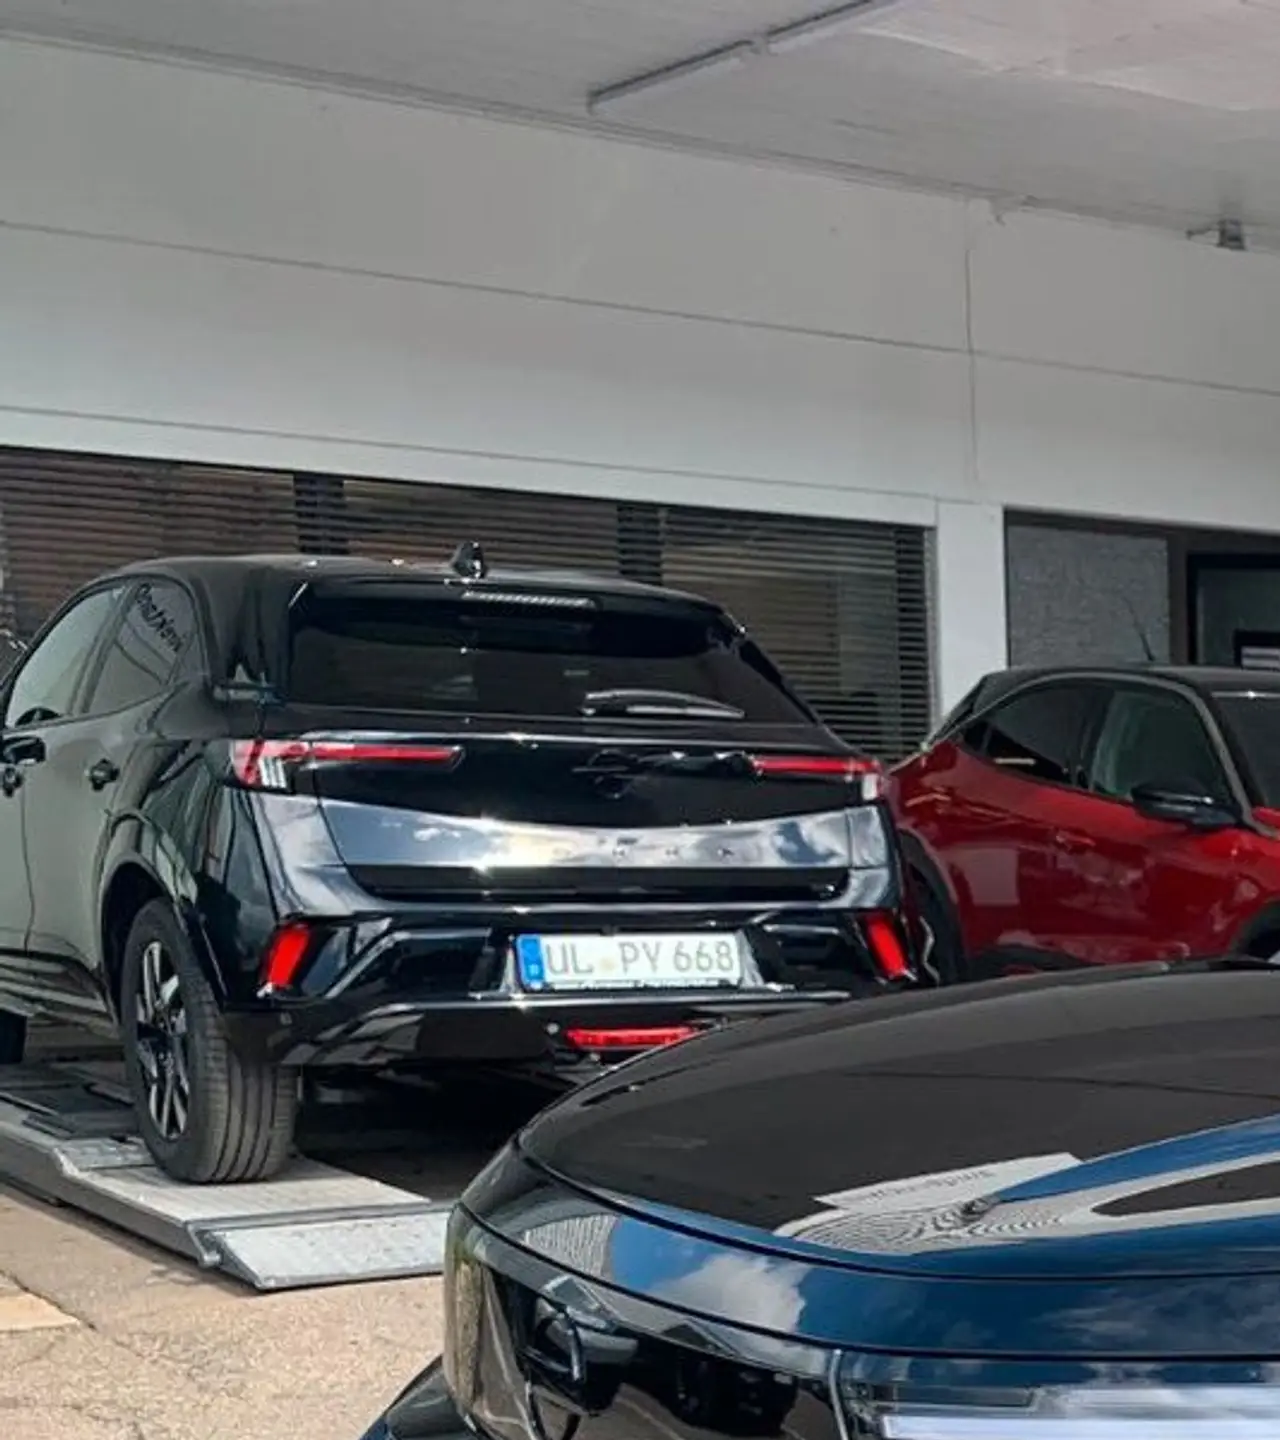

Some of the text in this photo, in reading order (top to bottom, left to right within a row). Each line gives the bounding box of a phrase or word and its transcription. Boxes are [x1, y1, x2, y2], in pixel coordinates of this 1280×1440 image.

[546, 940, 734, 974] UL PY 668
